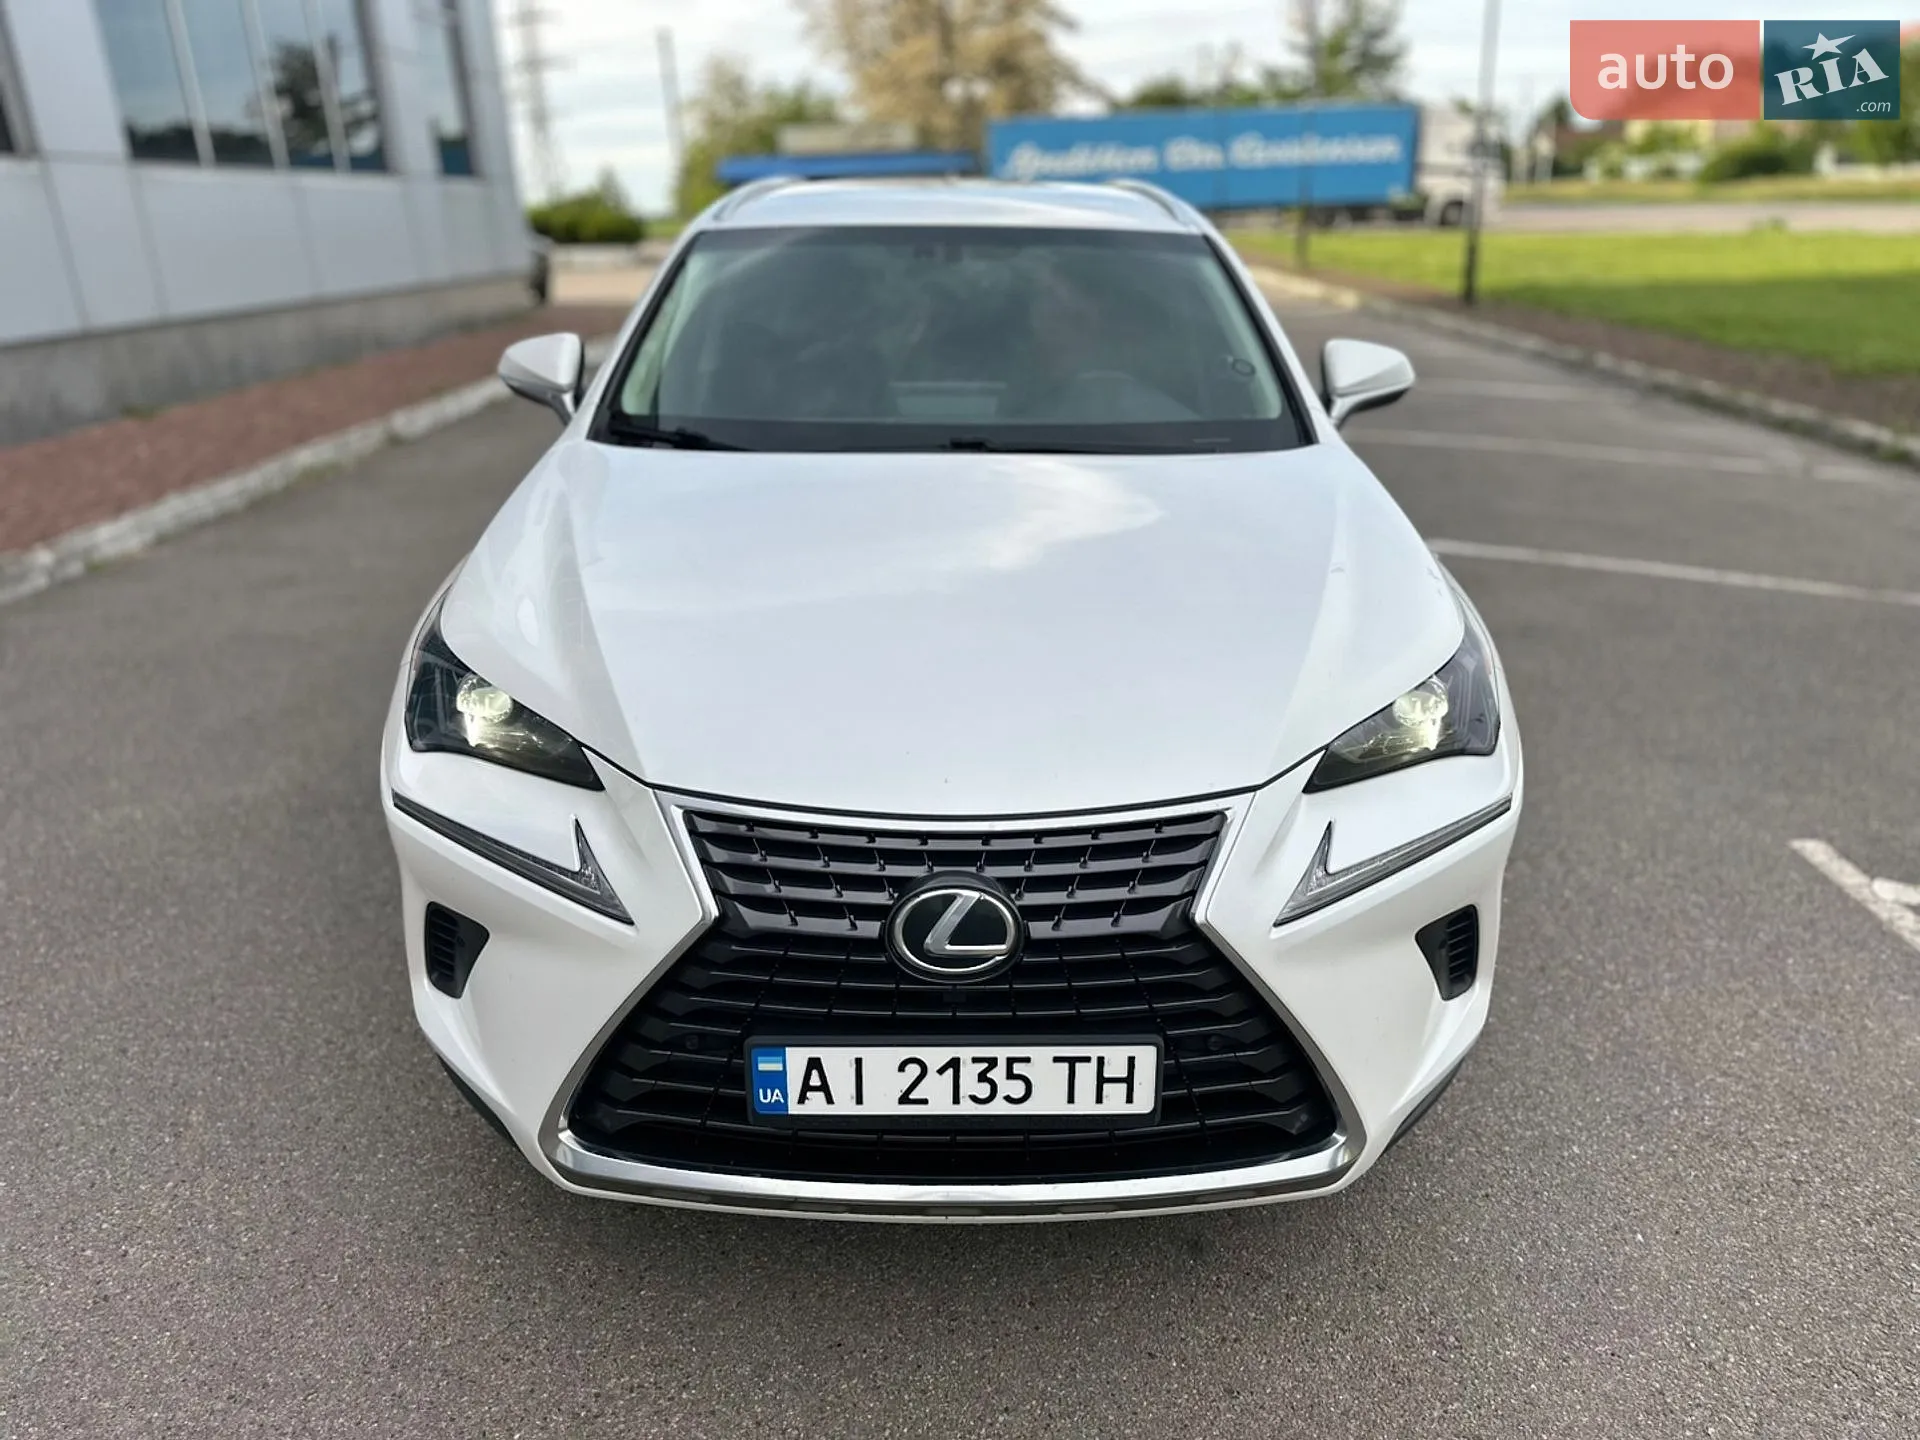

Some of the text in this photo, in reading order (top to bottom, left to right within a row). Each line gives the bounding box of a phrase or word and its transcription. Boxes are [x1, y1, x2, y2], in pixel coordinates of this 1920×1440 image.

[758, 1088, 785, 1103] UA
[797, 1056, 1136, 1105] AI 2135 TH
